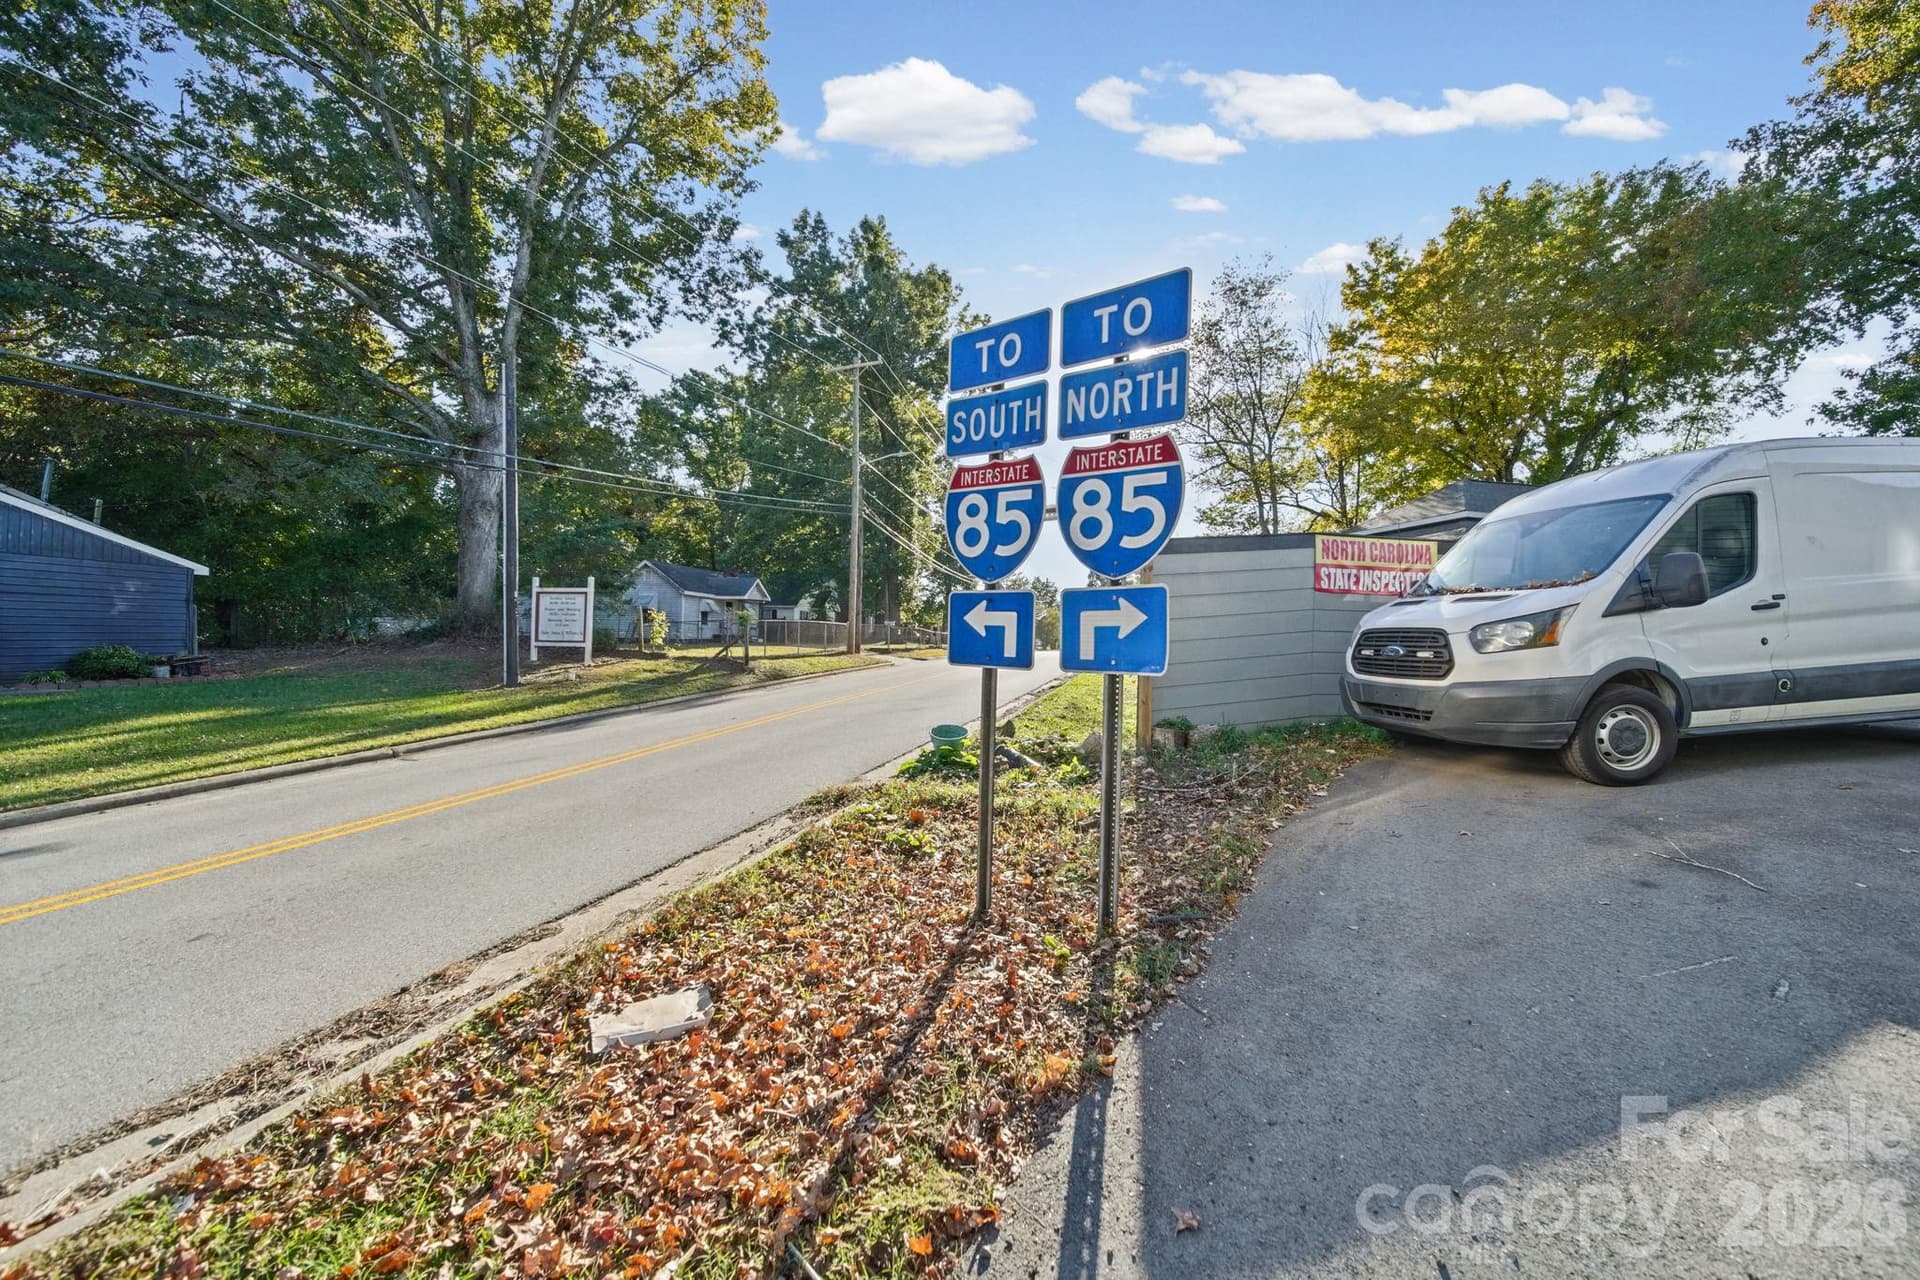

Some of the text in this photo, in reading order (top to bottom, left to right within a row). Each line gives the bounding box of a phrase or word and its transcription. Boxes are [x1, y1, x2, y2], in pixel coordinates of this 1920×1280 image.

[1094, 297, 1152, 344] TO
[975, 332, 1022, 373] TO
[1066, 367, 1178, 425] NORTH
[951, 395, 1042, 444] SOUTH
[960, 464, 1030, 487] INTERSTATE
[1076, 443, 1164, 471] INTERSTATE
[955, 488, 1033, 558] 85
[1069, 471, 1168, 551] 85
[1321, 539, 1432, 565] NORTH CAROLINA
[1320, 567, 1429, 593] STATE INSPECT
